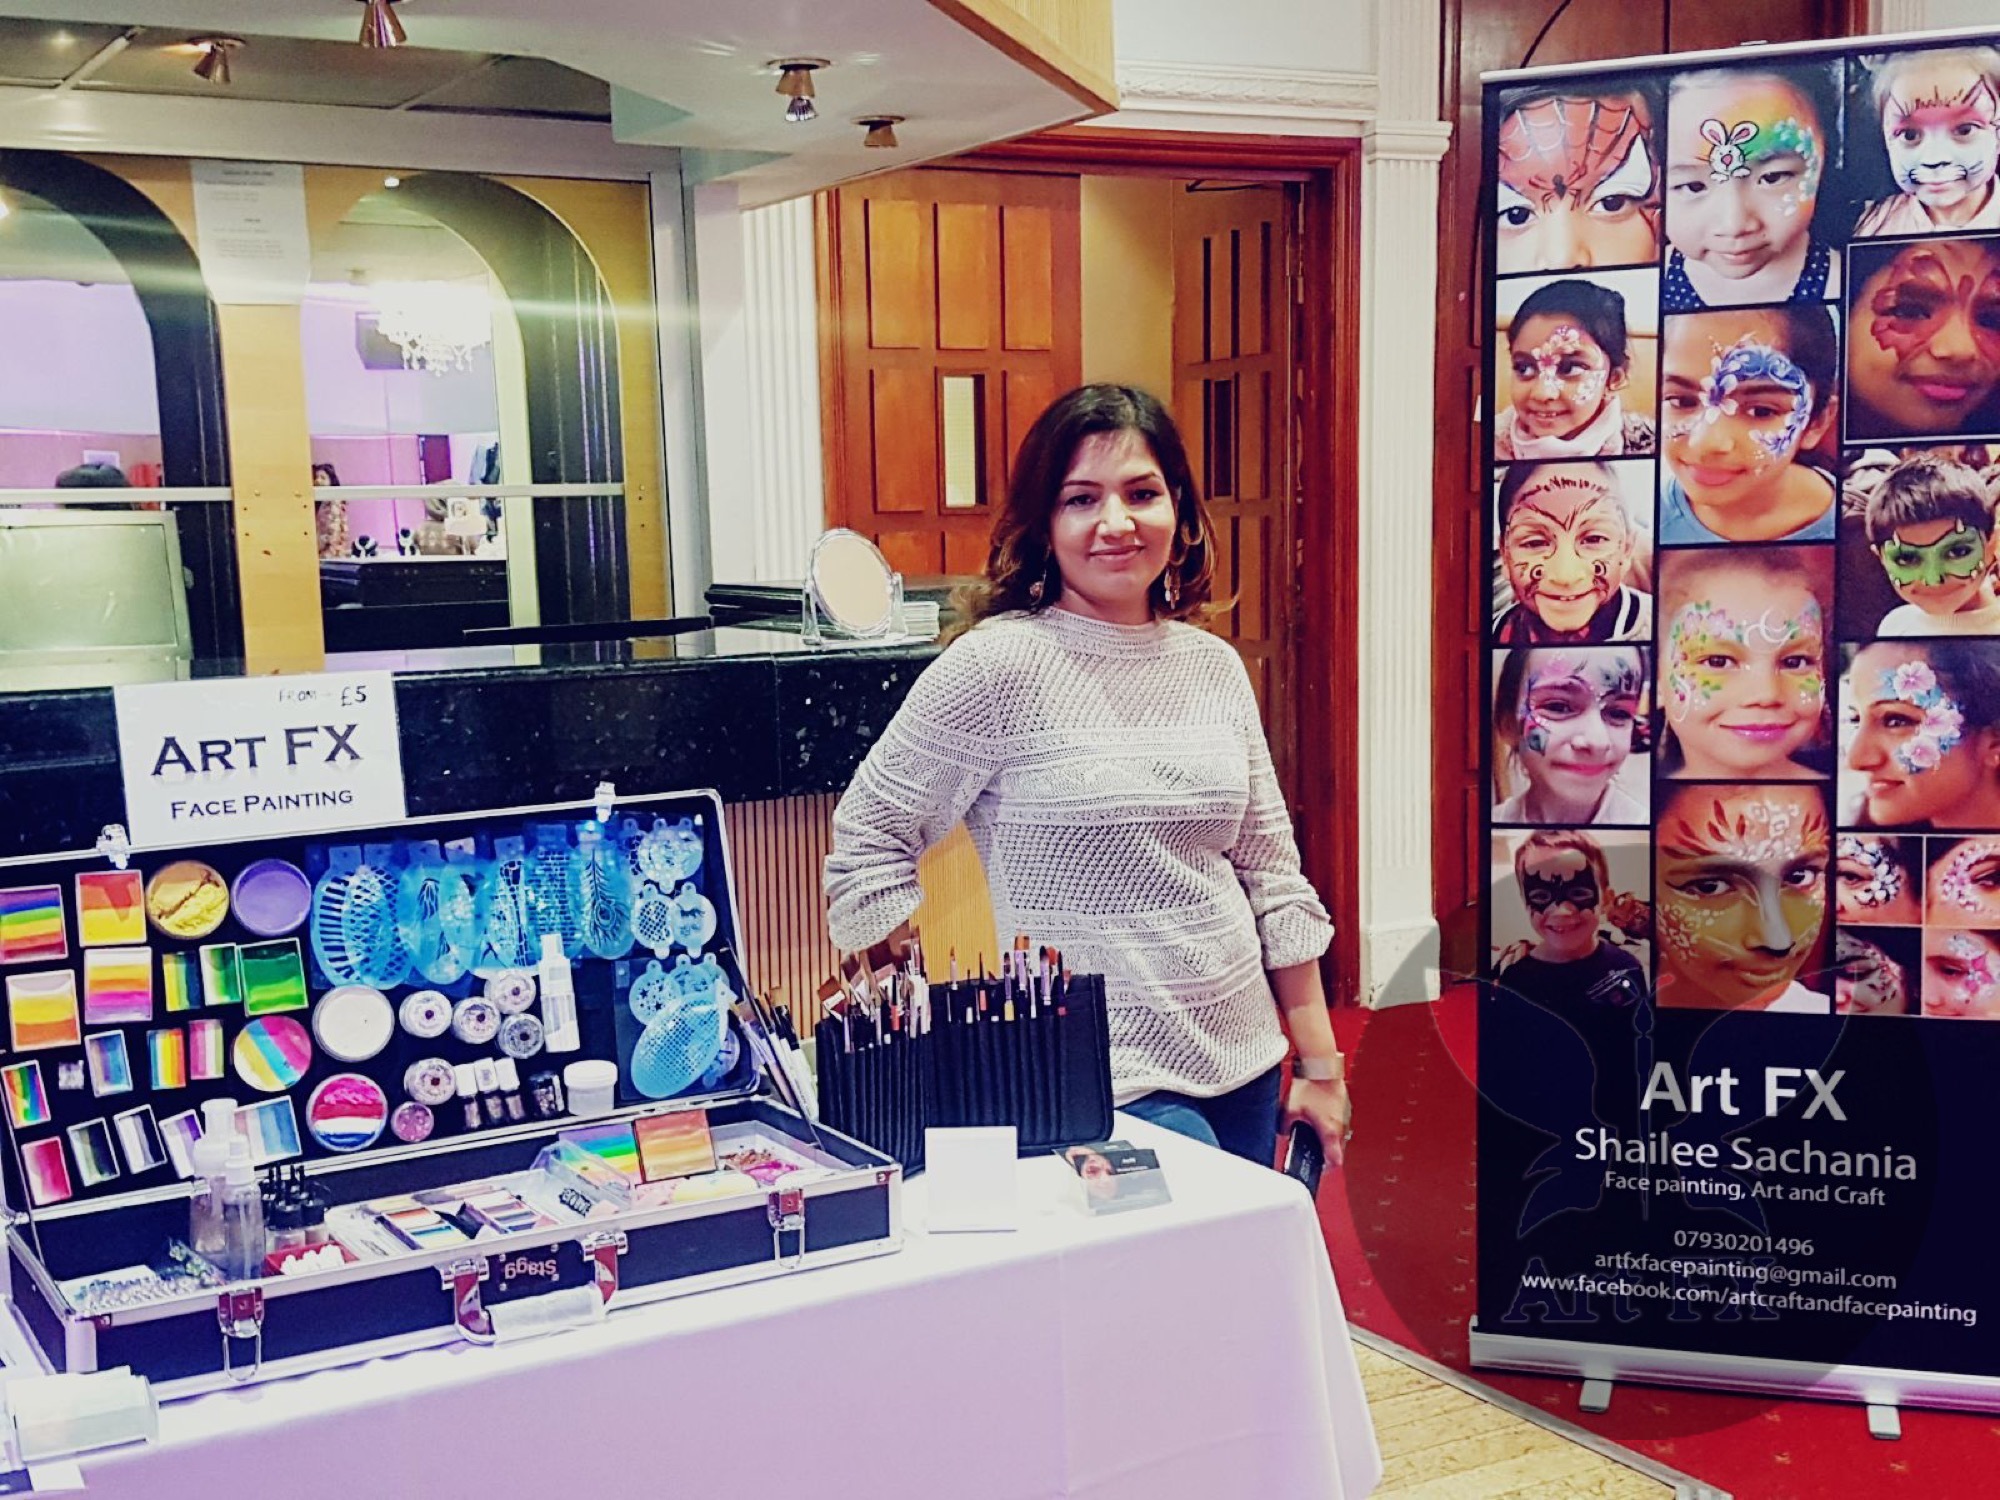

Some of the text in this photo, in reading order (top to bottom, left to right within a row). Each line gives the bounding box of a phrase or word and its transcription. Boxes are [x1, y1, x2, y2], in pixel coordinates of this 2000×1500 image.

[340, 684, 367, 707] £5
[284, 724, 363, 765] FX
[1640, 1061, 1847, 1121] Art FX
[1574, 1127, 1917, 1181] Shailee Sachania
[1605, 1171, 1886, 1207] Face painting, Art and Craft
[1674, 1229, 1815, 1257] 07930201496
[504, 1257, 557, 1279] Stagg
[1594, 1251, 1897, 1290] artfxfacepainting@gmail.com
[1521, 1274, 1977, 1327] www.facebook.com/artcraftandfacepainting
